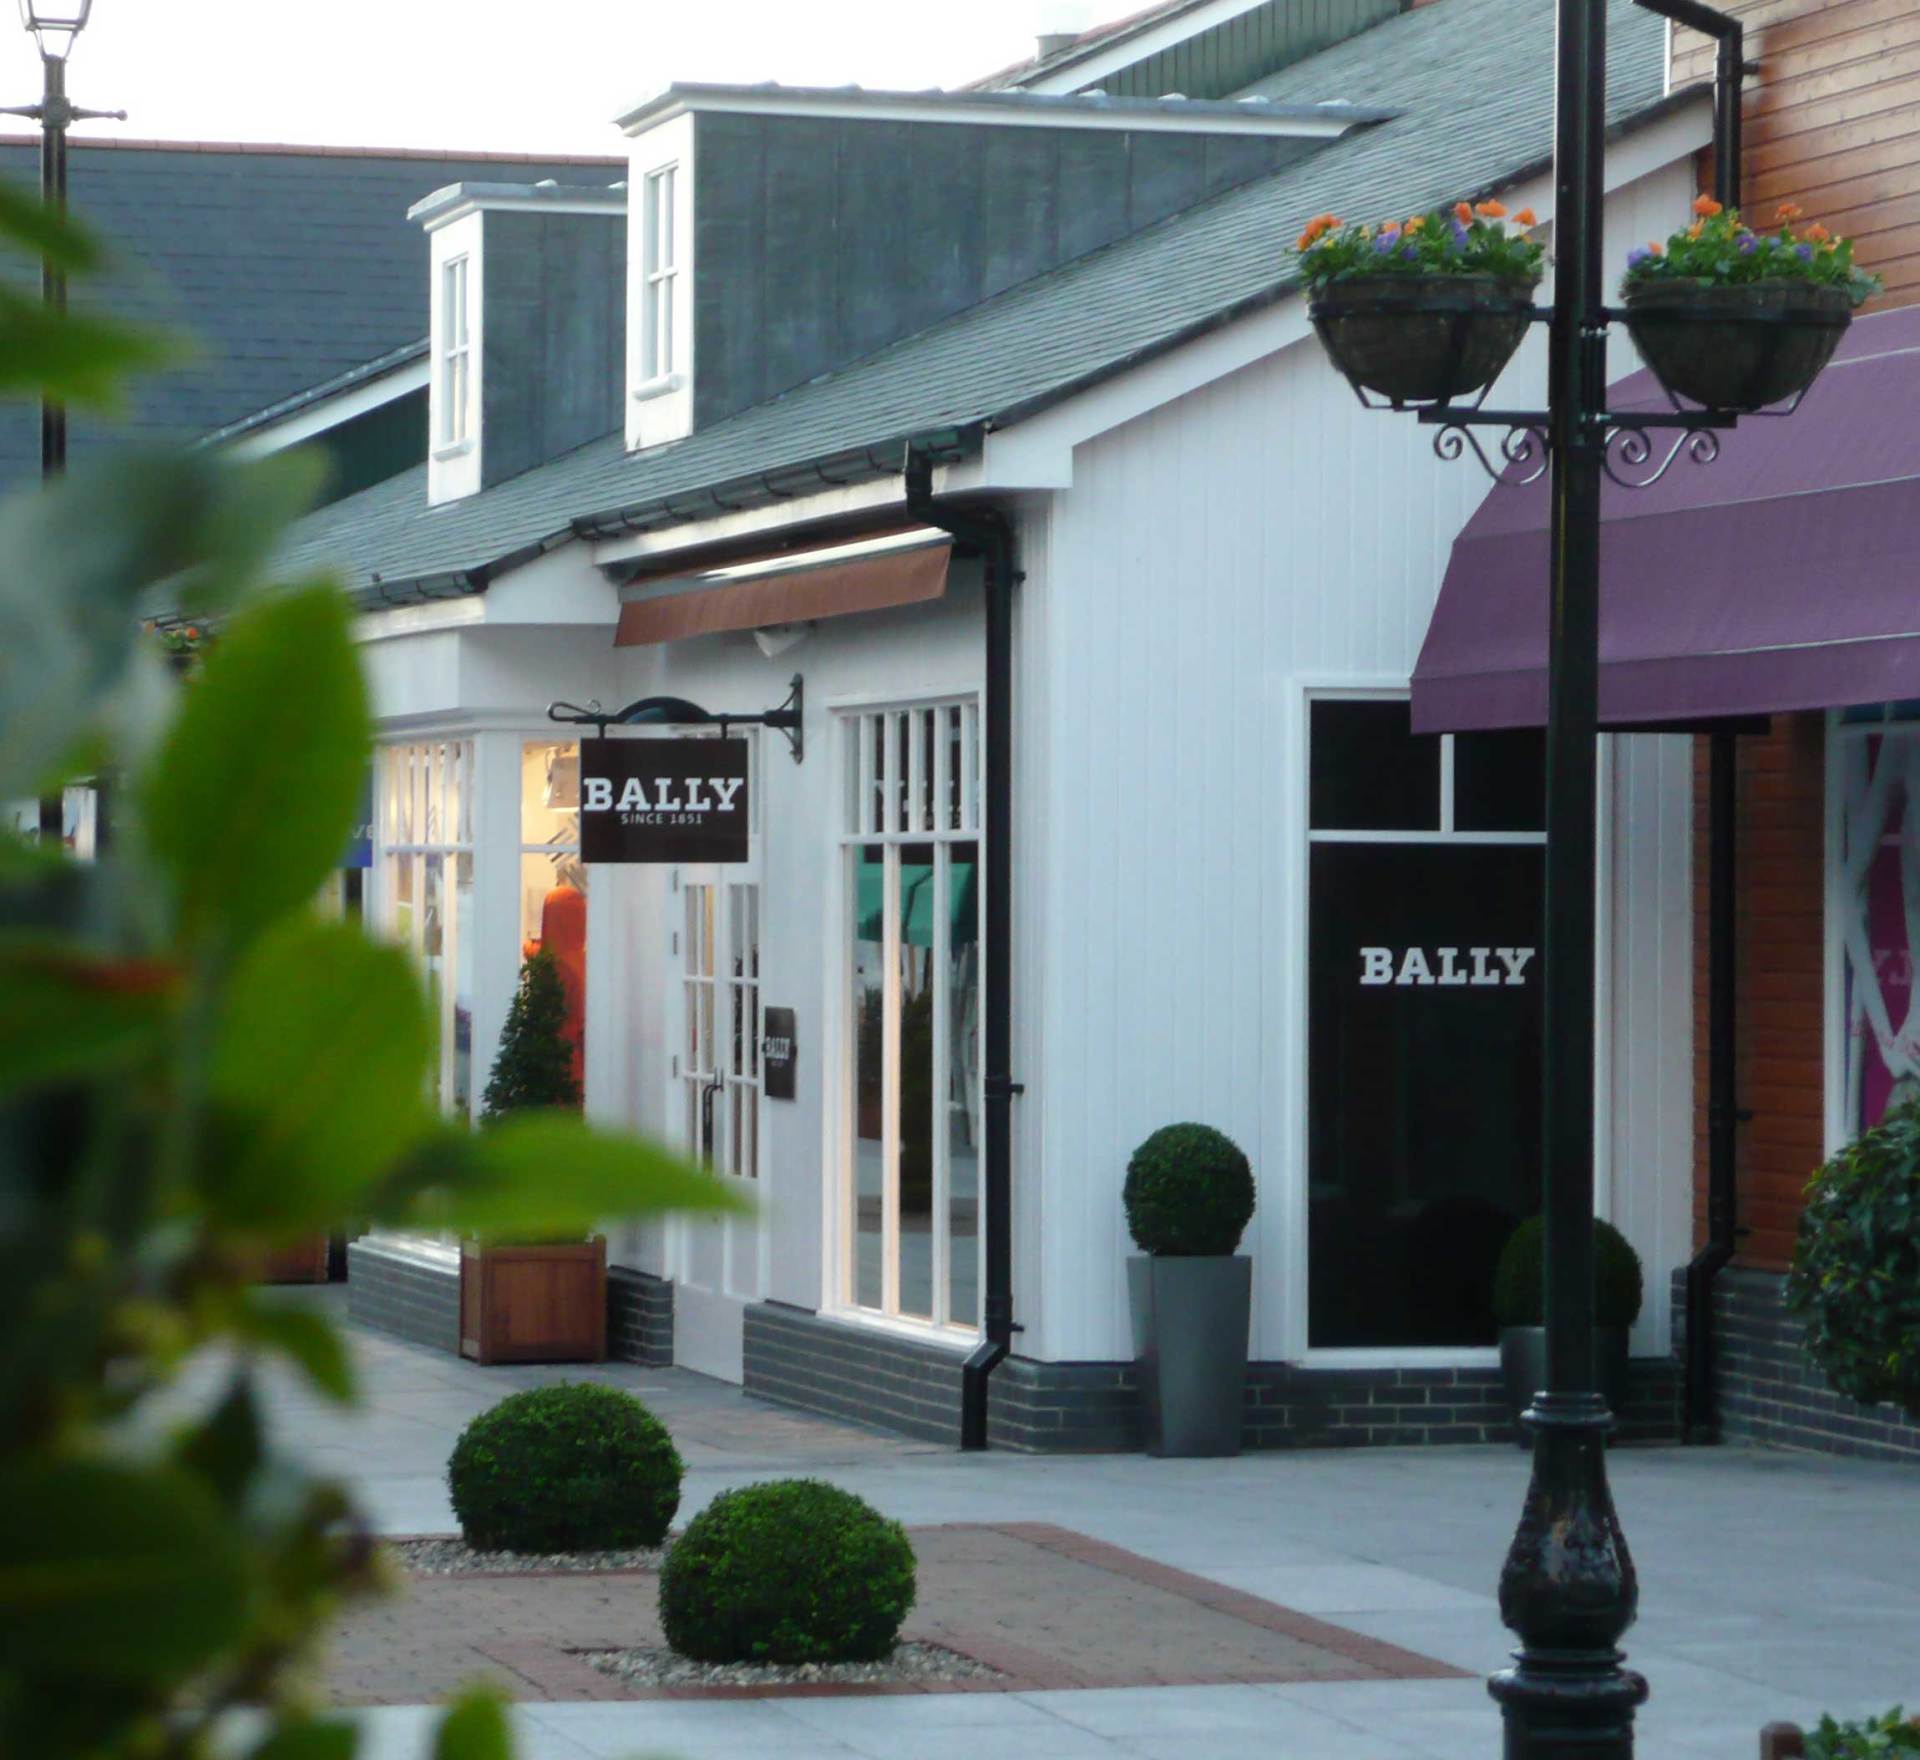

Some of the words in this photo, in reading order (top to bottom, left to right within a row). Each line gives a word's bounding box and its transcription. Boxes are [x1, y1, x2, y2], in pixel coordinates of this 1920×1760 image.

[583, 777, 745, 812] BALLY
[621, 812, 664, 825] SINCE
[670, 812, 703, 825] 1851
[1359, 946, 1536, 985] BALLY
